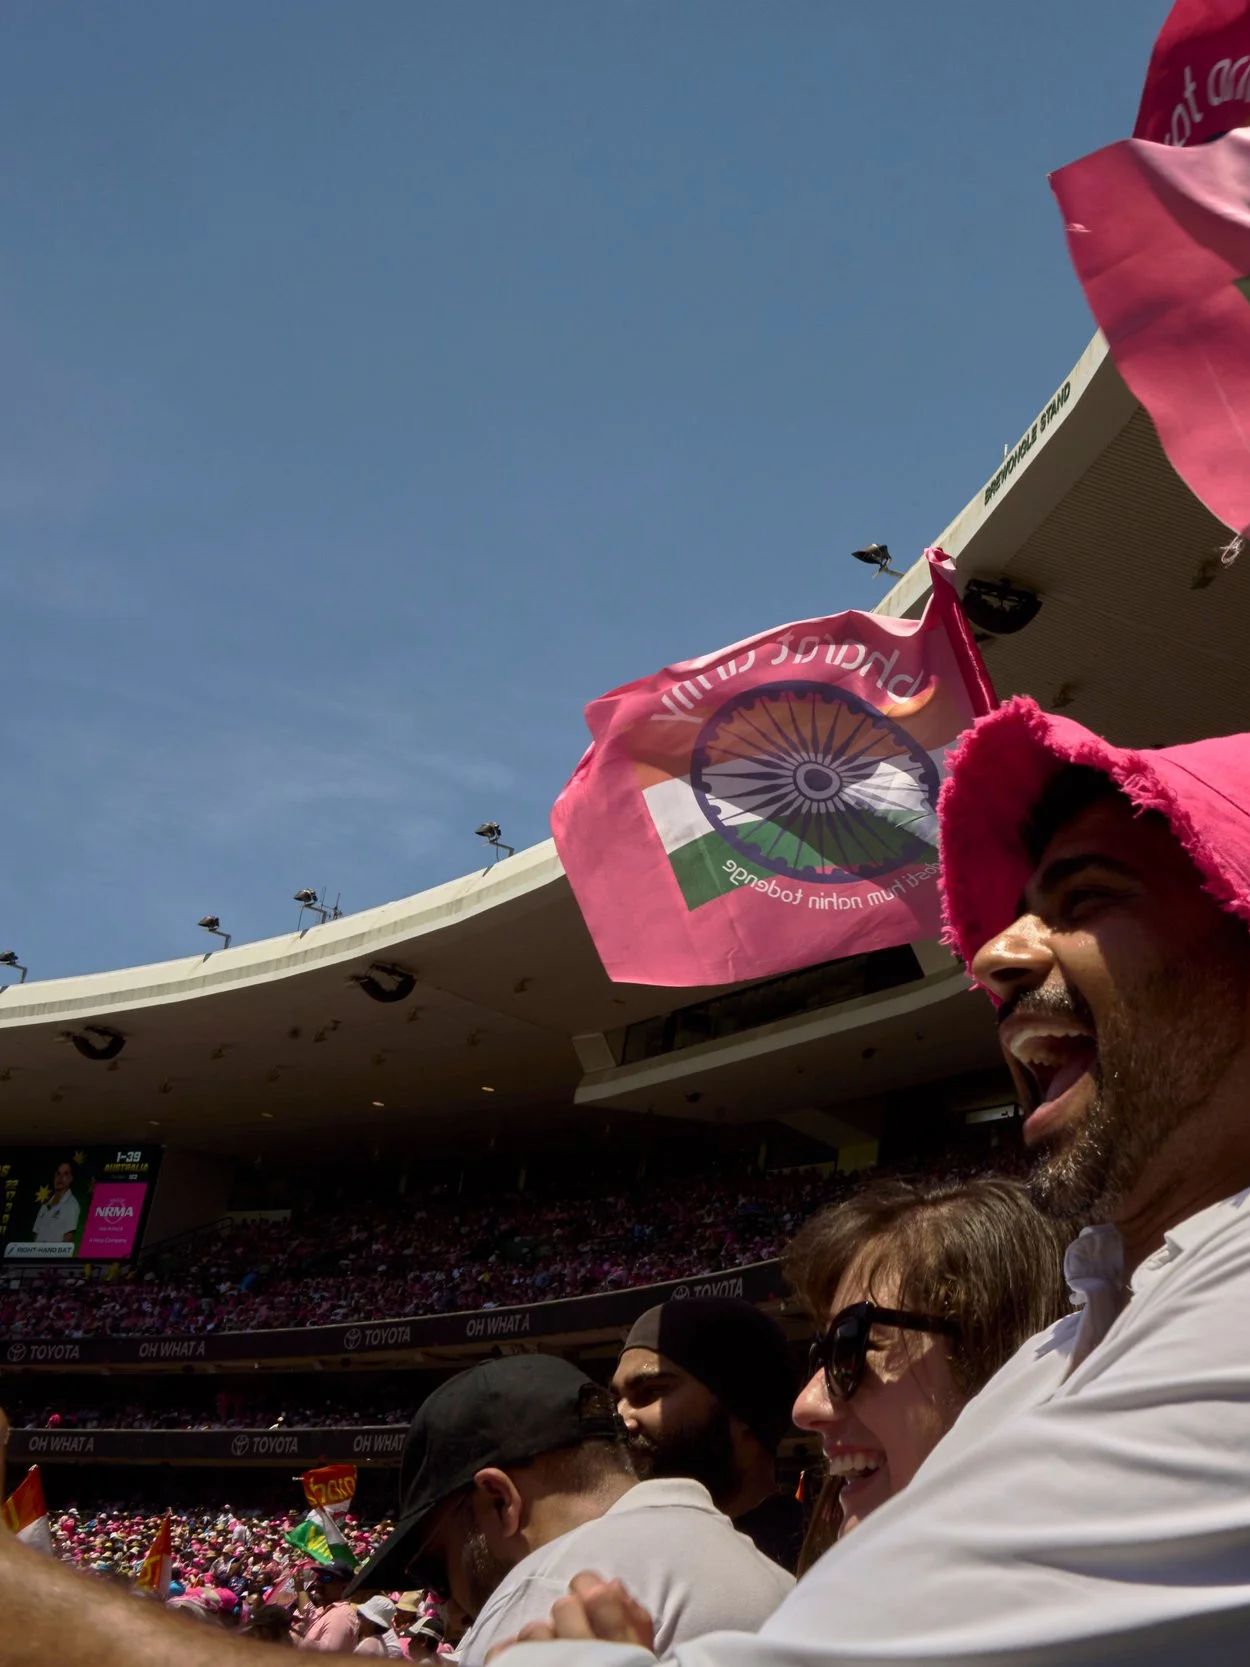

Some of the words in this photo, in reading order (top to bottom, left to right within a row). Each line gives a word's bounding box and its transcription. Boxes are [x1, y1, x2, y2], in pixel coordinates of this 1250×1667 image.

[984, 424, 1038, 506] BREWONGLE
[1039, 381, 1072, 433] STAND
[116, 1151, 142, 1163] 1-39
[103, 1163, 149, 1173] AUSTRALIA
[95, 1206, 134, 1218] NRMA
[466, 1319, 483, 1336] OH
[486, 1316, 518, 1335] WHAT
[518, 1313, 529, 1331] A
[365, 1326, 411, 1345] TOYOTA
[30, 1344, 80, 1360] TOYOTA
[139, 1342, 158, 1358] OH
[160, 1341, 195, 1358] WHAT
[195, 1341, 206, 1356] A
[28, 1436, 48, 1452] OH
[49, 1436, 85, 1452] WHAT
[84, 1436, 95, 1452] A
[252, 1436, 298, 1454] TOYOTA
[353, 1434, 373, 1452] OH
[373, 1433, 406, 1452] WHAT
